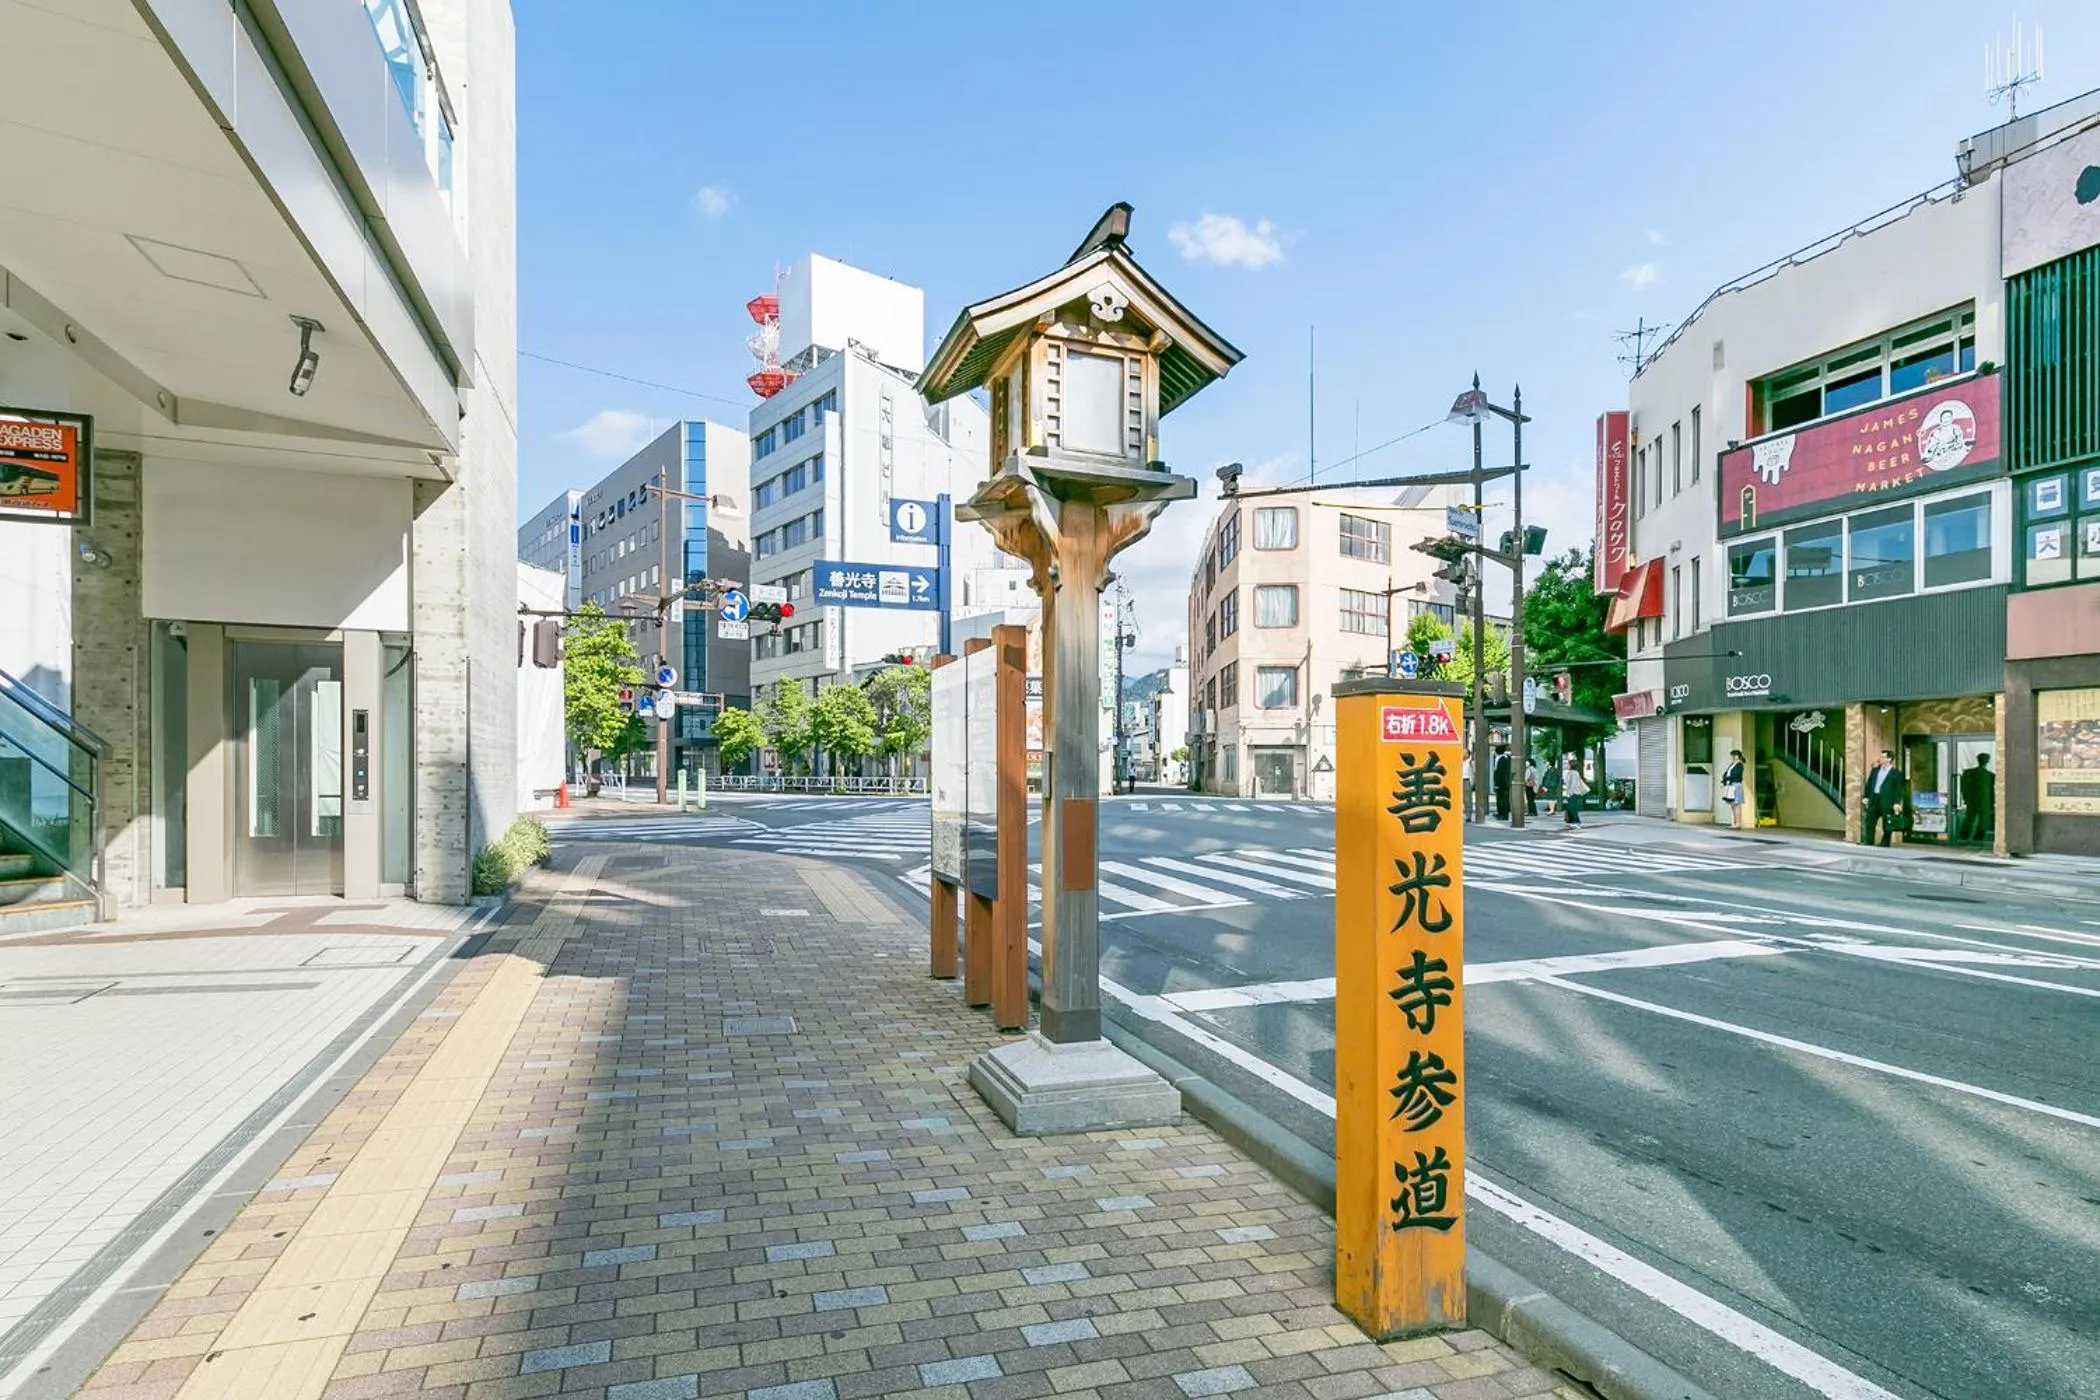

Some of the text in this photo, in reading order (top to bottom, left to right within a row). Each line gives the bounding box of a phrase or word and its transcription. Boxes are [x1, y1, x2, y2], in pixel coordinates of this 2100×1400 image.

[1860, 408, 1919, 433] JAMES
[1852, 428, 1928, 455] NAGANO
[1867, 453, 1910, 472] BEER
[1854, 468, 1925, 493] MARKET
[829, 570, 877, 589] 善光寺
[819, 588, 877, 600] Zenkoji Temple
[1725, 673, 1771, 691] BOSCO
[1387, 750, 1458, 1232] 善光寺参道
